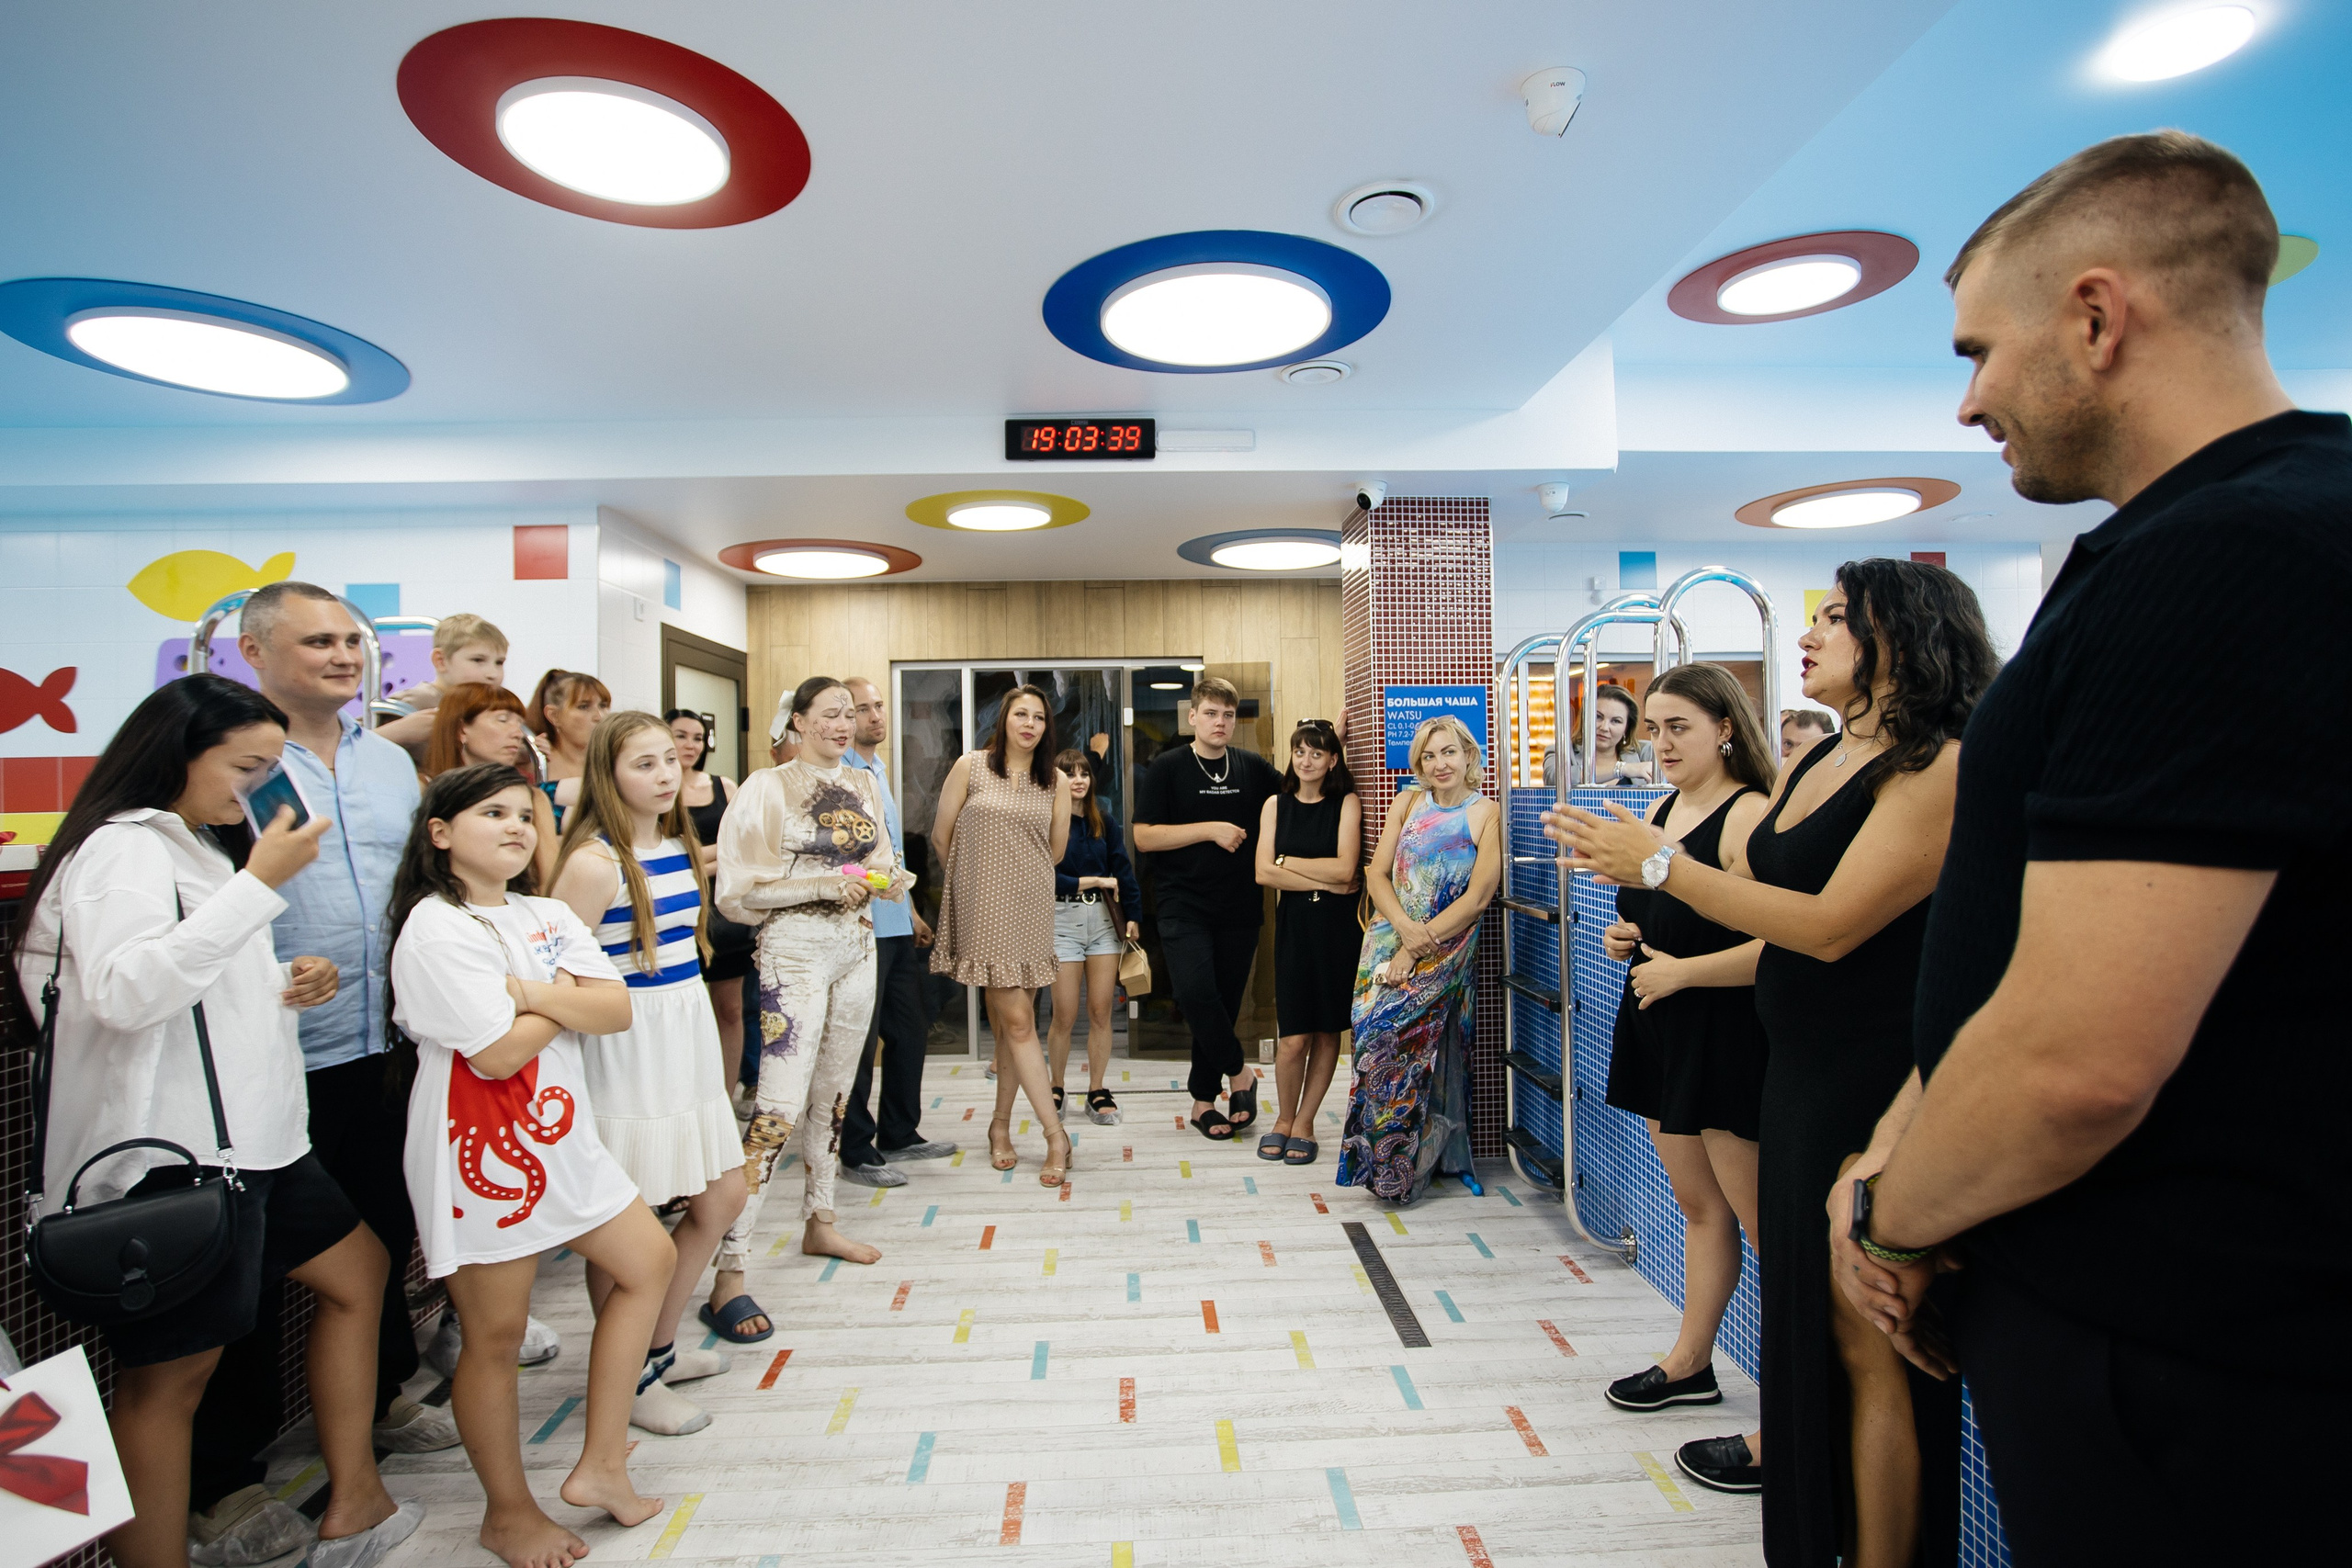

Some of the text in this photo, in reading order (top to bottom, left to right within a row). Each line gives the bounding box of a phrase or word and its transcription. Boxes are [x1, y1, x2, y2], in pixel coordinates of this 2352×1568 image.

[1031, 425, 1141, 451] 19:03:39
[1386, 696, 1478, 707] БОЛЬШАЯ ЧАША
[1387, 710, 1422, 721] WATSU
